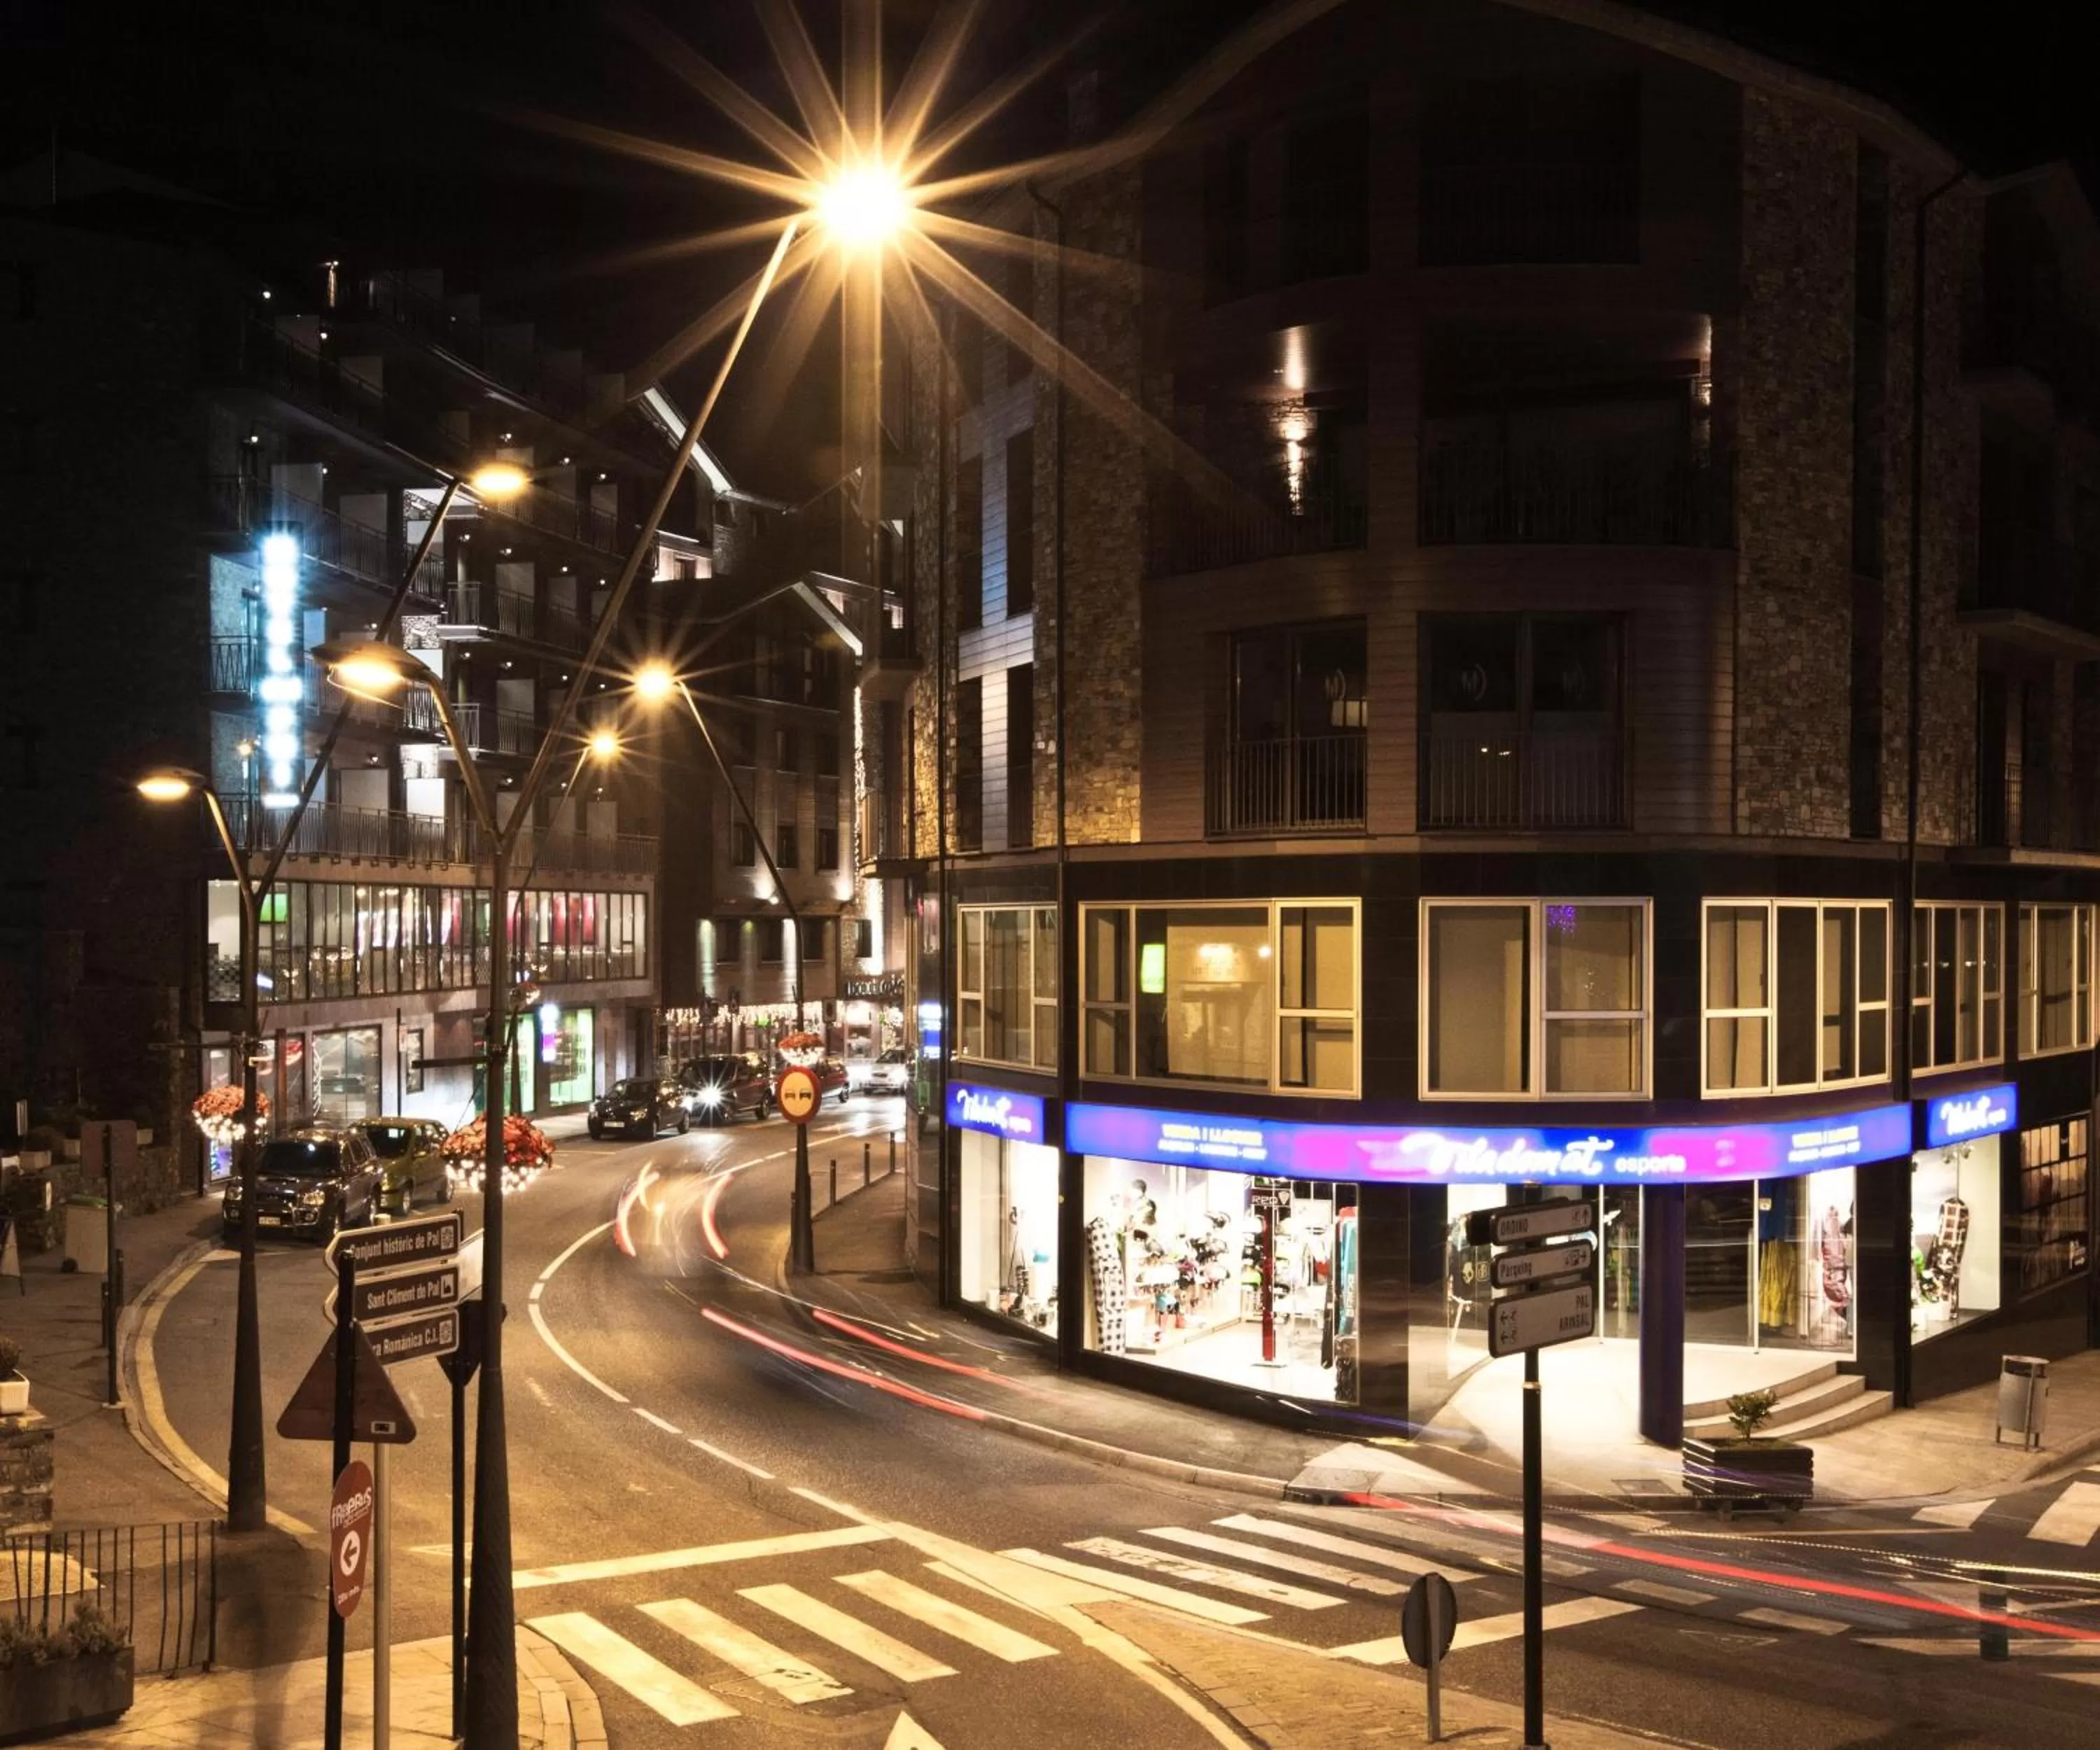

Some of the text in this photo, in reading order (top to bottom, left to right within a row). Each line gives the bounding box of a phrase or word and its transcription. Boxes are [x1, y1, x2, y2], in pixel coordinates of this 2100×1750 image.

[415, 1233, 425, 1249] de
[427, 1230, 440, 1247] Pal
[368, 1280, 440, 1310] Sant Climent de Pal
